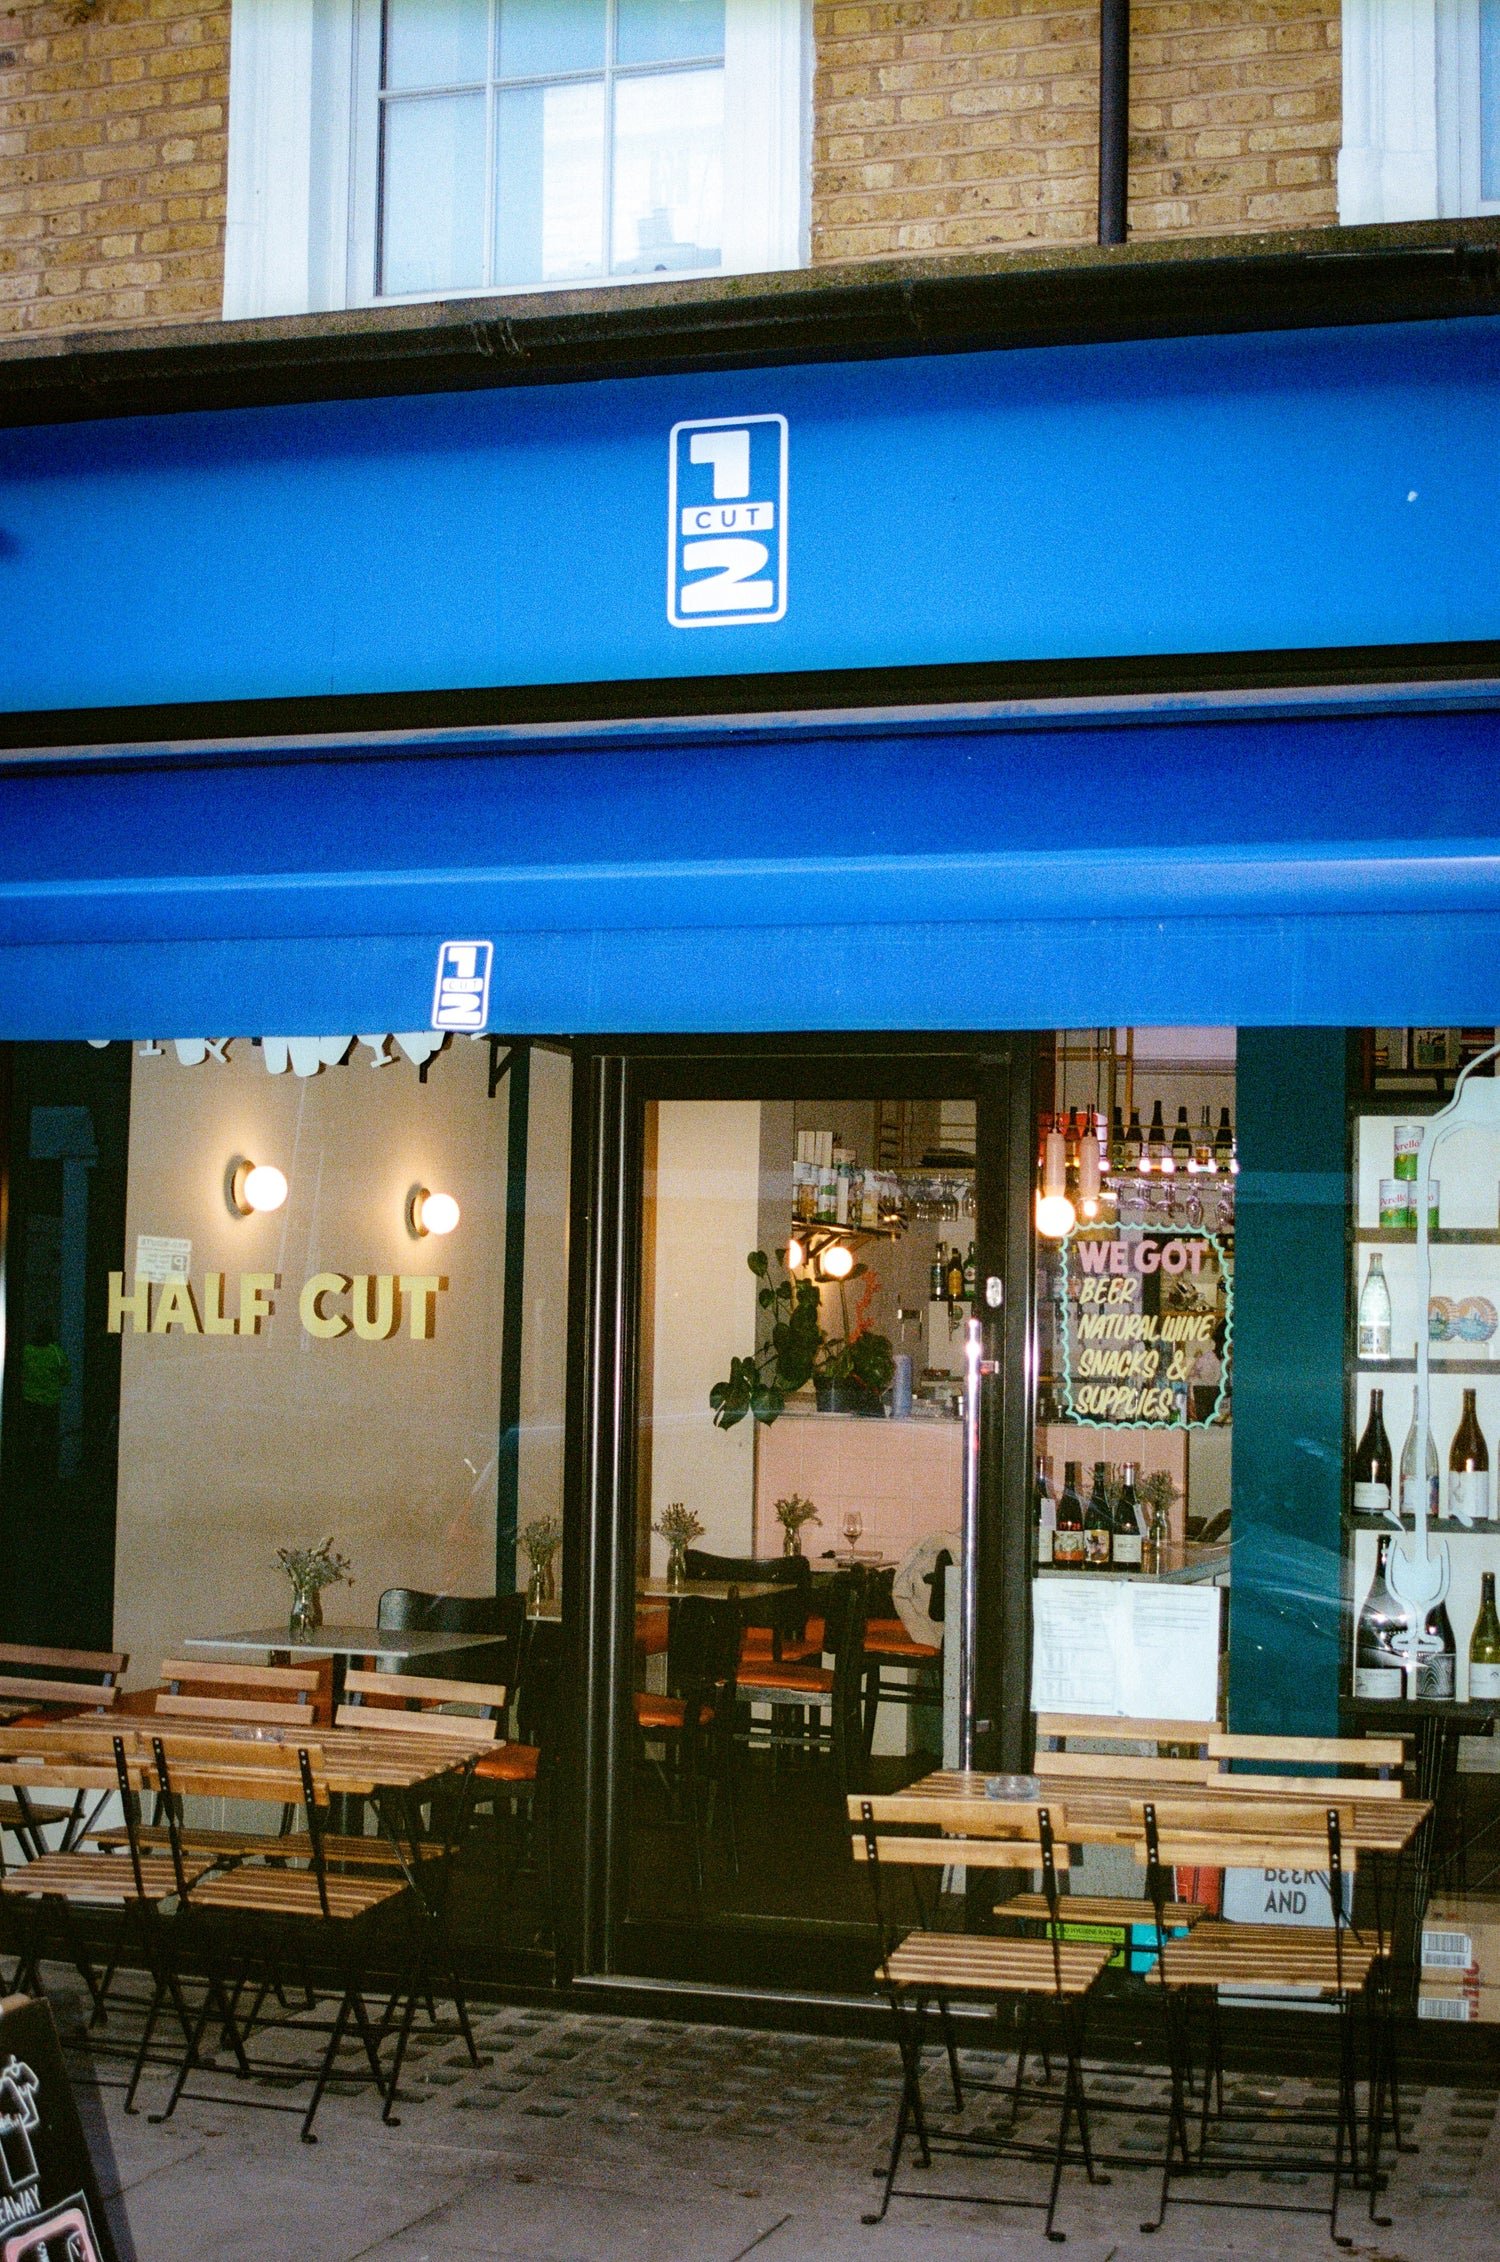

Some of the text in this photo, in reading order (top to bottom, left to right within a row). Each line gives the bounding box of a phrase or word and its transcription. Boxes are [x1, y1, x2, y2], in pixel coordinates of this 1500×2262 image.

[690, 430, 750, 500] 1
[695, 508, 760, 529] CUT
[681, 538, 774, 613] 2
[448, 947, 477, 978] 1
[437, 993, 483, 1024] 2
[1077, 1240, 1208, 1274] WE GOT
[107, 1271, 446, 1341] HALF CUT
[1079, 1277, 1137, 1305] BEER
[1077, 1313, 1215, 1342] NATURAL WINE
[1077, 1348, 1189, 1381] SNACKS &
[1076, 1385, 1173, 1416] SUPPLIES
[1264, 1889, 1307, 1914] AND
